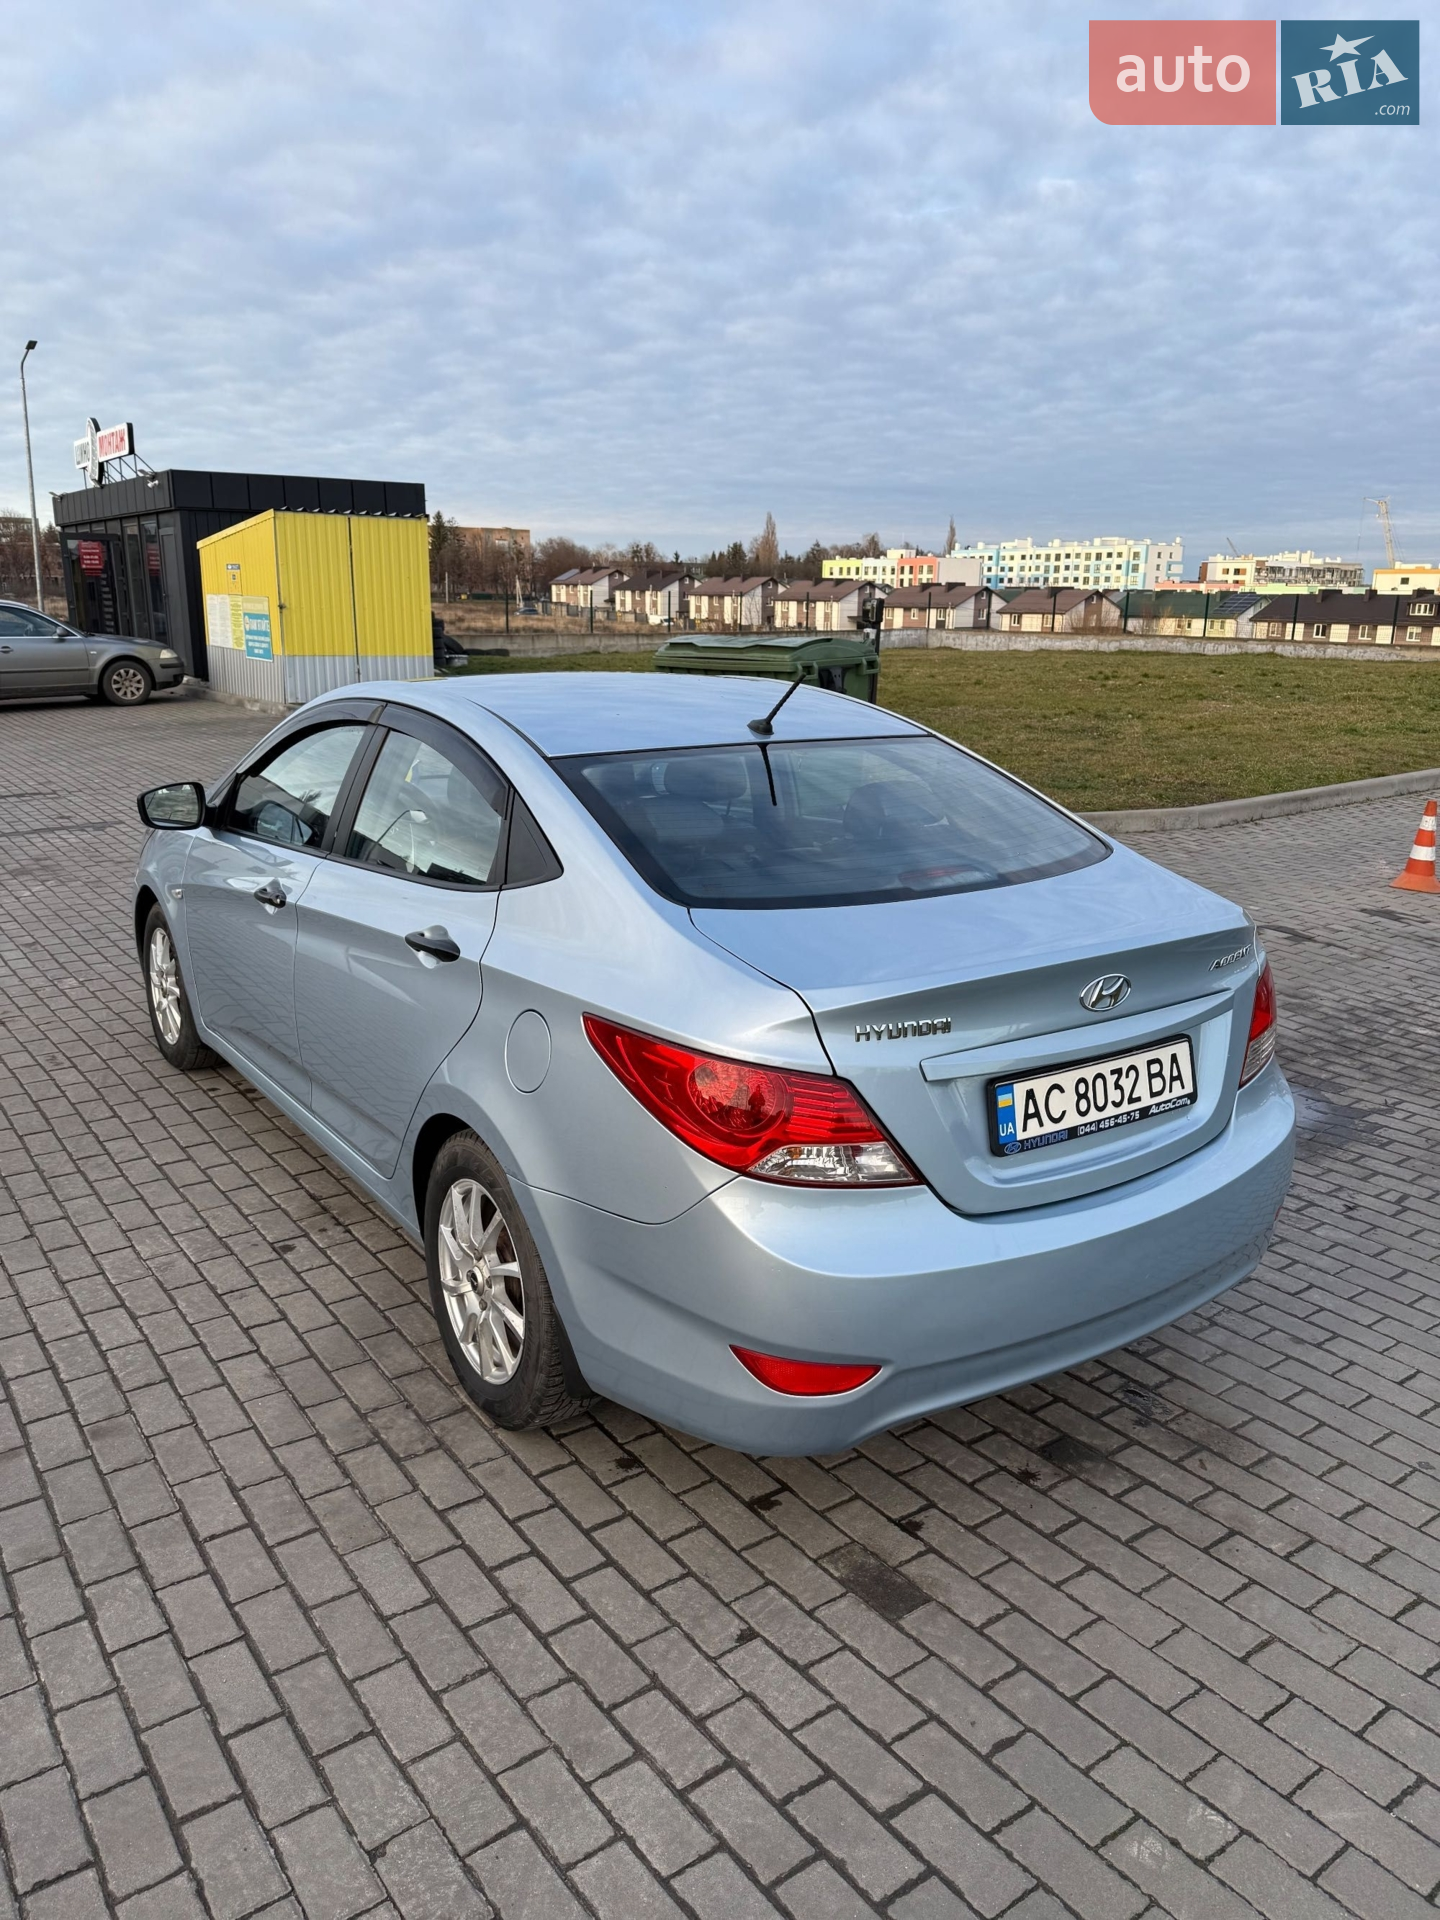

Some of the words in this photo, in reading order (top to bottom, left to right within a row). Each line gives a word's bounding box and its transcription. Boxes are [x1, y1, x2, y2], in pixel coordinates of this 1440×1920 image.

[854, 1016, 952, 1043] HYUNDAI
[1022, 1082, 1067, 1133] AC
[1074, 1064, 1142, 1117] 8032
[1146, 1052, 1186, 1099] BA
[999, 1123, 1015, 1137] UA
[1023, 1129, 1069, 1151] HYUNDAI
[1077, 1120, 1098, 1137] (044)
